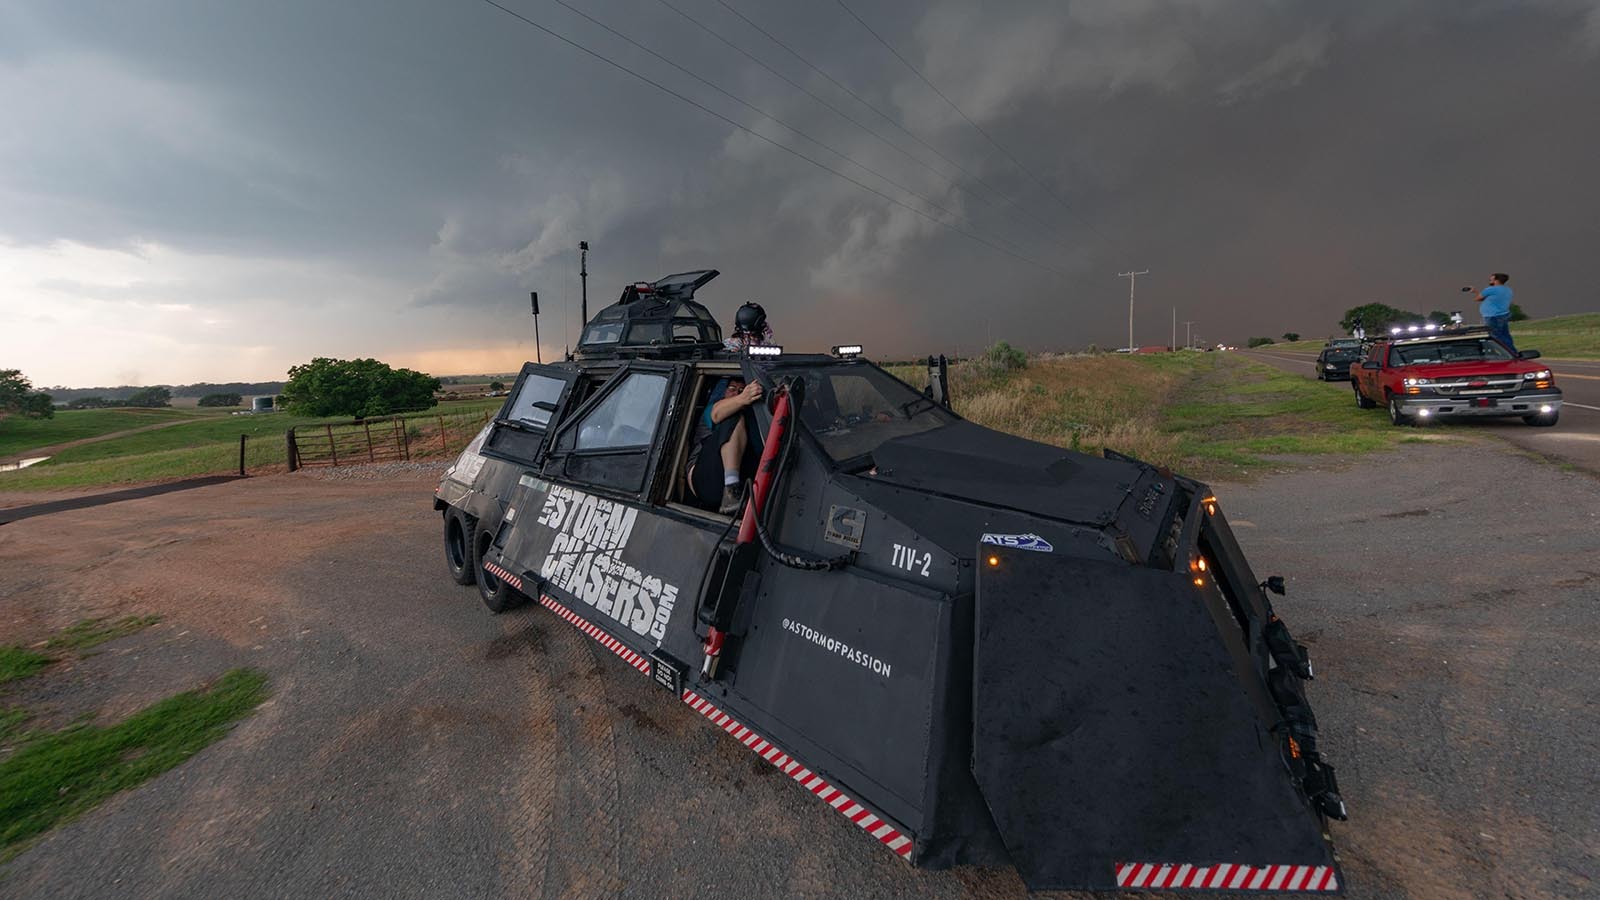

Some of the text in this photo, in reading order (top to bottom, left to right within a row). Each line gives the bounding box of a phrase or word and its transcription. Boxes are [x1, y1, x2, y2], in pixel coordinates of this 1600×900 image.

[537, 484, 562, 526] LIVE
[548, 487, 639, 559] STORM
[891, 543, 932, 578] TIV-2
[983, 535, 1019, 545] ATS
[541, 531, 663, 636] CHASERS
[782, 618, 892, 678] @ASTORMOFPASSION
